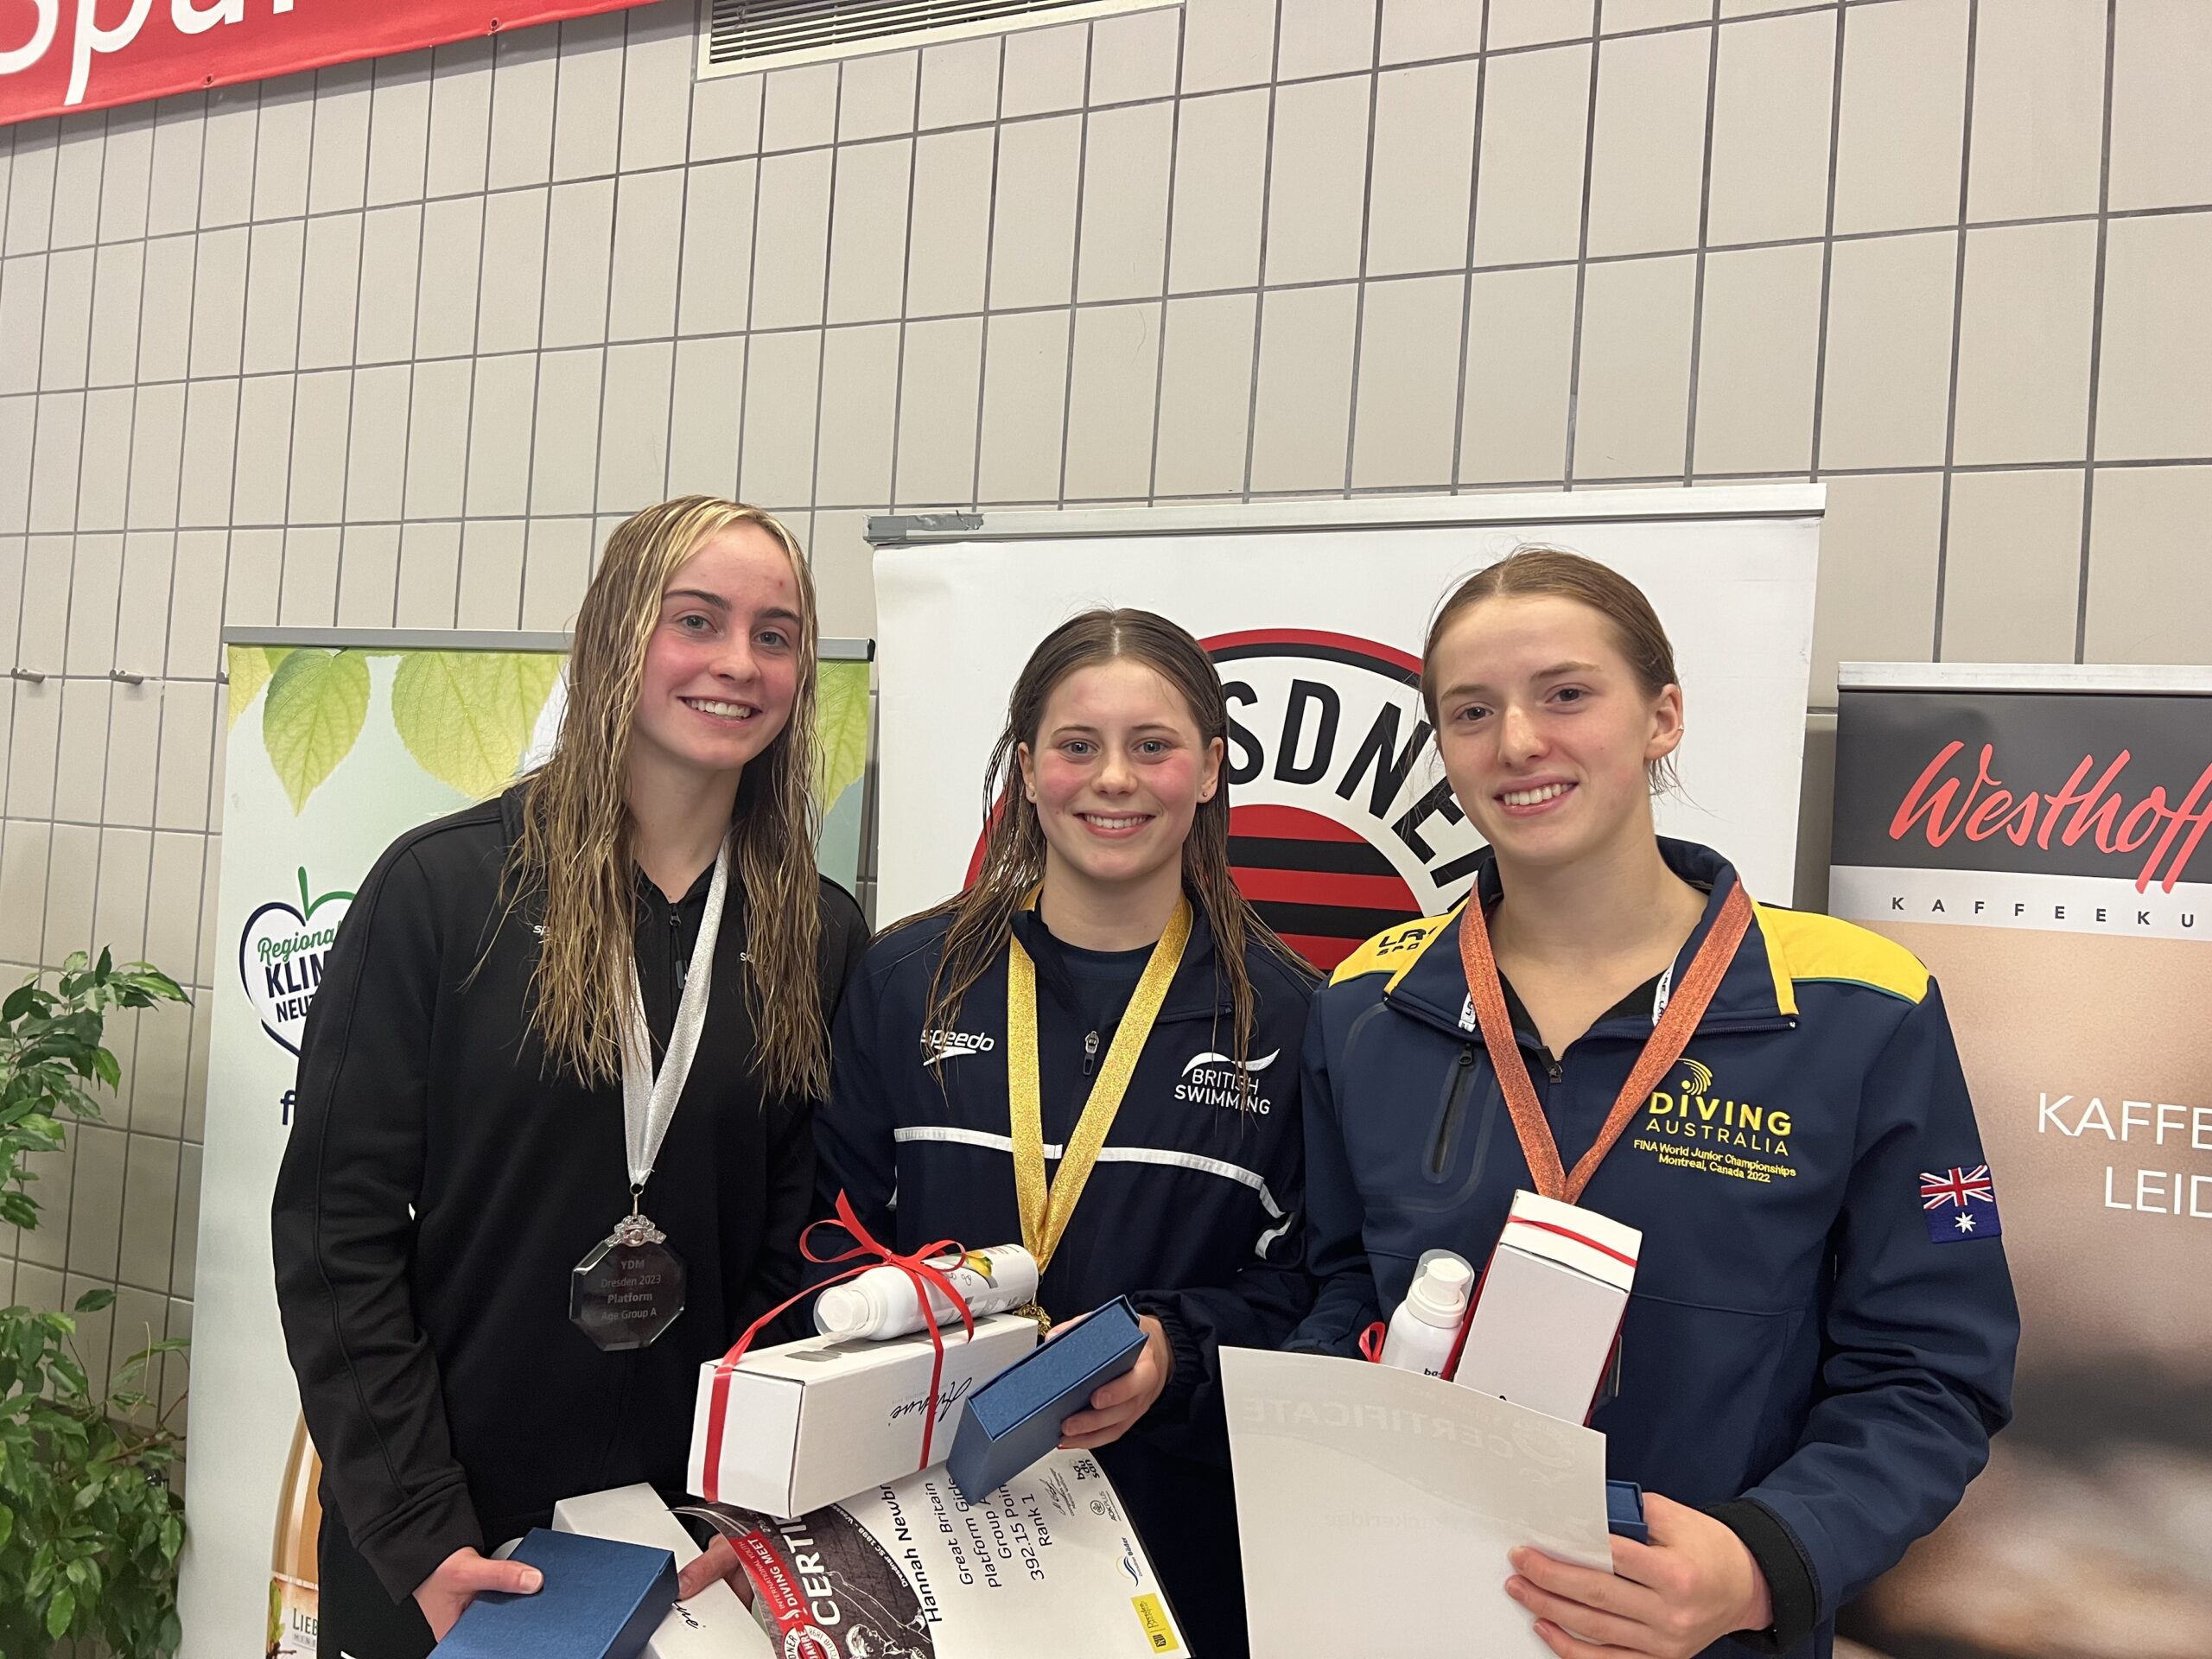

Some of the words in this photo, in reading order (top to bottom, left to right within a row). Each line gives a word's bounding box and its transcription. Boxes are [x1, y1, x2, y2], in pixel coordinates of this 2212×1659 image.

[1892, 896, 2195, 928] KAFFEEKU
[257, 920, 343, 967] Regiona
[276, 995, 315, 1023] NEU
[920, 1029, 995, 1052] speedo
[1649, 1091, 1792, 1137] DIVING
[1645, 1118, 1789, 1156] AUSTRALIA
[1633, 1139, 1658, 1153] FINA
[1659, 1142, 1689, 1157] World
[1691, 1147, 1724, 1162] Junior
[1725, 1154, 1796, 1178] Championships
[1659, 1154, 1707, 1171] Montreal,
[1709, 1162, 1745, 1179] Canada
[1747, 1171, 1771, 1183] 2022
[601, 1277, 637, 1288] Dresden
[639, 1274, 661, 1285] 2023
[621, 1260, 645, 1269] YDM
[607, 1293, 653, 1304] Platform
[622, 1309, 648, 1320] Group
[650, 1307, 658, 1316] A
[925, 1483, 953, 1534] Britain
[1021, 1493, 1036, 1505] 1
[986, 1511, 1013, 1560] Group
[1027, 1507, 1052, 1547] Rank
[738, 1541, 755, 1560] YOUTH
[747, 1539, 774, 1565] MEET
[948, 1537, 974, 1586] Great
[965, 1517, 1002, 1588] Platform
[1010, 1522, 1046, 1581] 392.15
[753, 1559, 785, 1610] INTERNATIONAL
[770, 1566, 798, 1607] DIVING
[904, 1548, 943, 1623] Hannah
